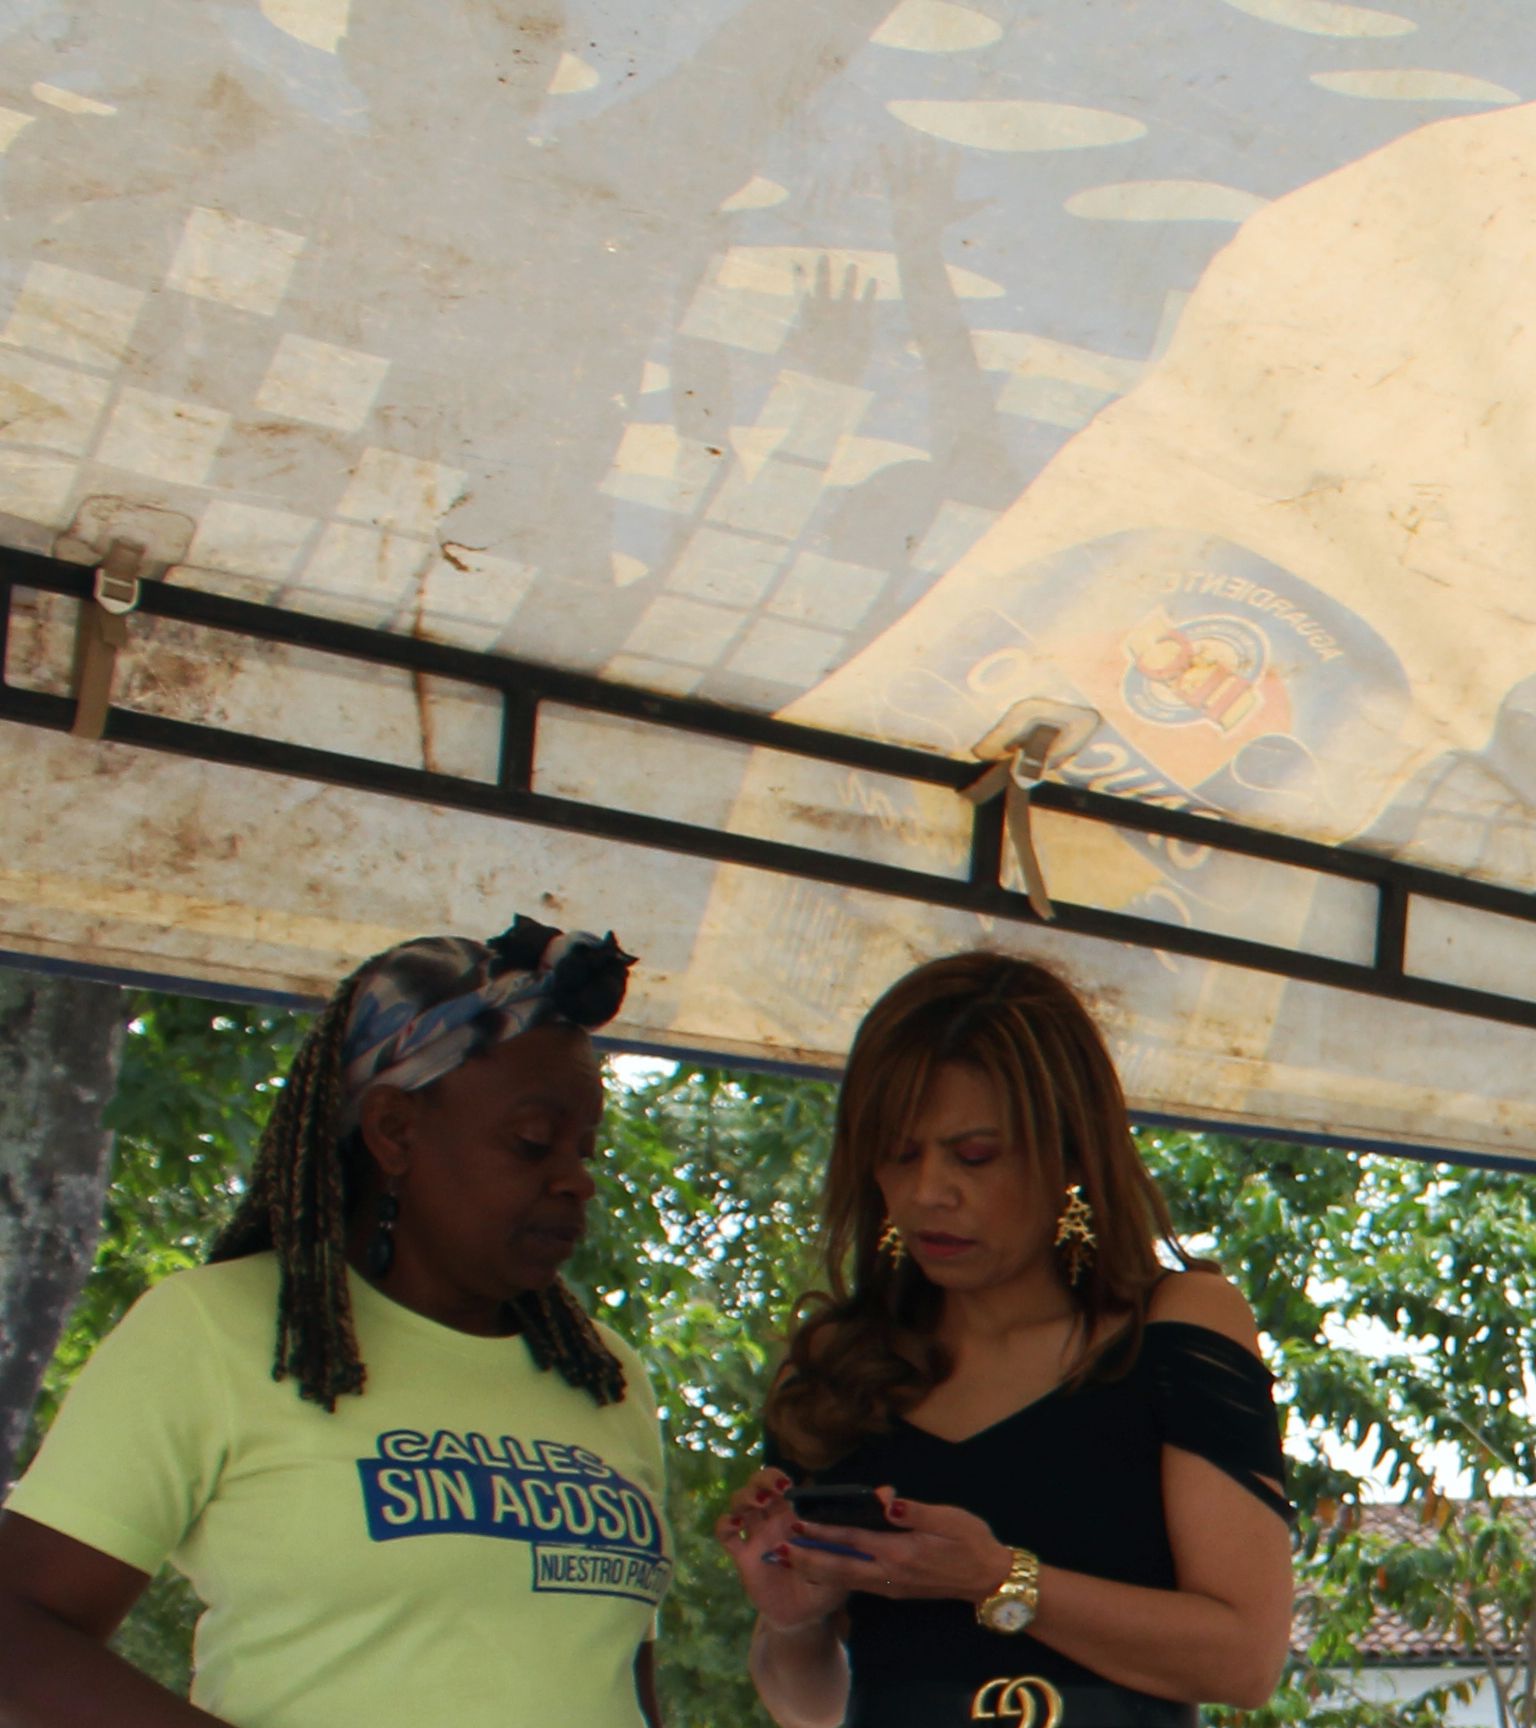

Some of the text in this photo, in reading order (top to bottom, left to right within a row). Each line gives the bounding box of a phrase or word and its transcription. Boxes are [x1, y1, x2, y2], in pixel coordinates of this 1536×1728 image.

[377, 1428, 613, 1480] CALLES
[376, 1466, 656, 1548] SIN ACOSO
[540, 1554, 622, 1584] NUESTRO
